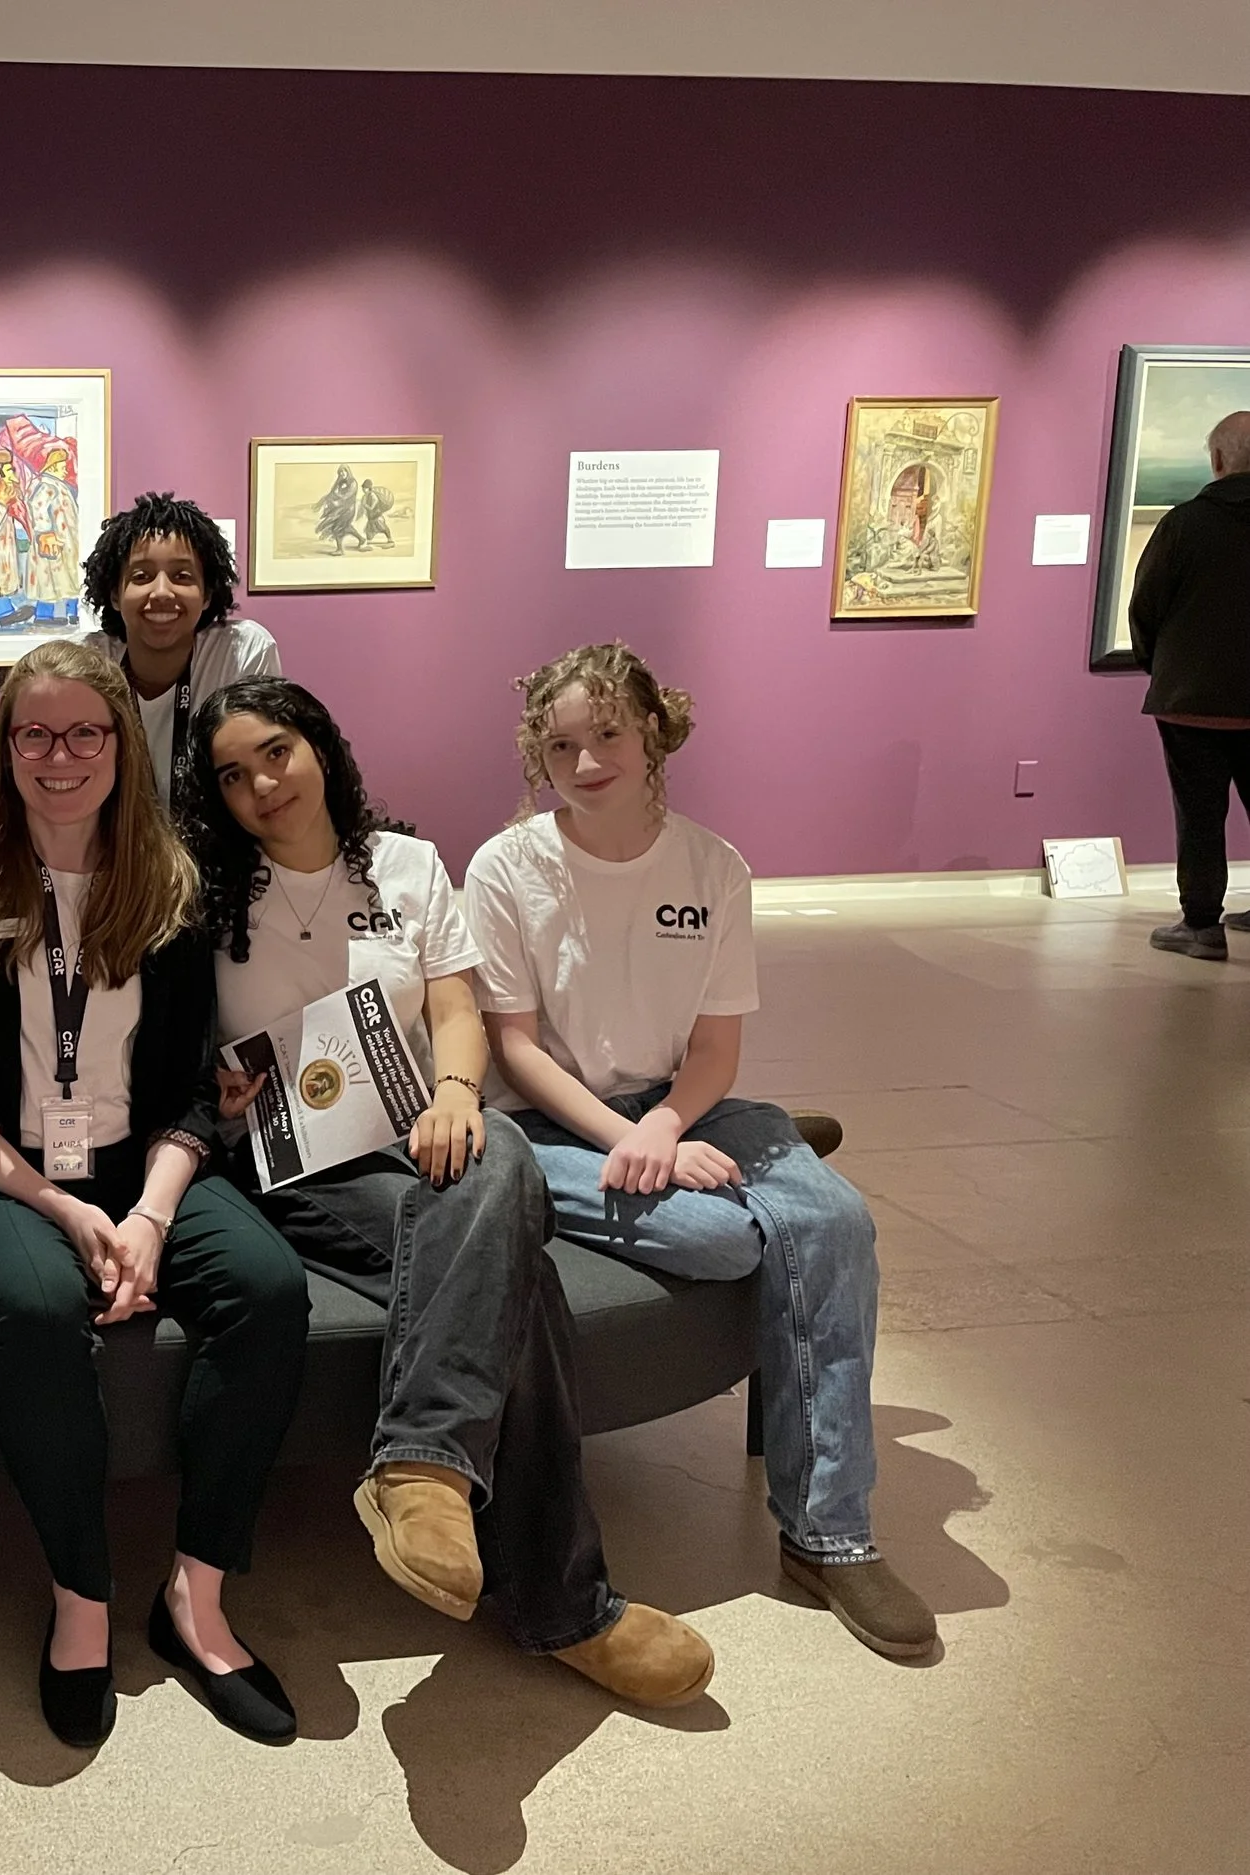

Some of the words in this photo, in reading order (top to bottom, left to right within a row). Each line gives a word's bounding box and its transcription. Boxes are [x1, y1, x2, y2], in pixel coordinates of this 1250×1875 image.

[577, 460, 620, 471] Burdens
[316, 1033, 370, 1084] spiral
[365, 1034, 383, 1072] celebrate
[380, 1073, 389, 1087] the
[386, 1088, 403, 1121] opening
[400, 1121, 410, 1130] of
[371, 1030, 383, 1046] join
[379, 1046, 387, 1057] us
[383, 1057, 392, 1067] at
[388, 1068, 397, 1082] the
[394, 1082, 412, 1116] museum
[382, 1026, 396, 1053] You're
[392, 1053, 410, 1083] invited!
[405, 1084, 420, 1111] Please
[268, 1064, 283, 1110] Saturday,
[280, 1111, 288, 1132] May
